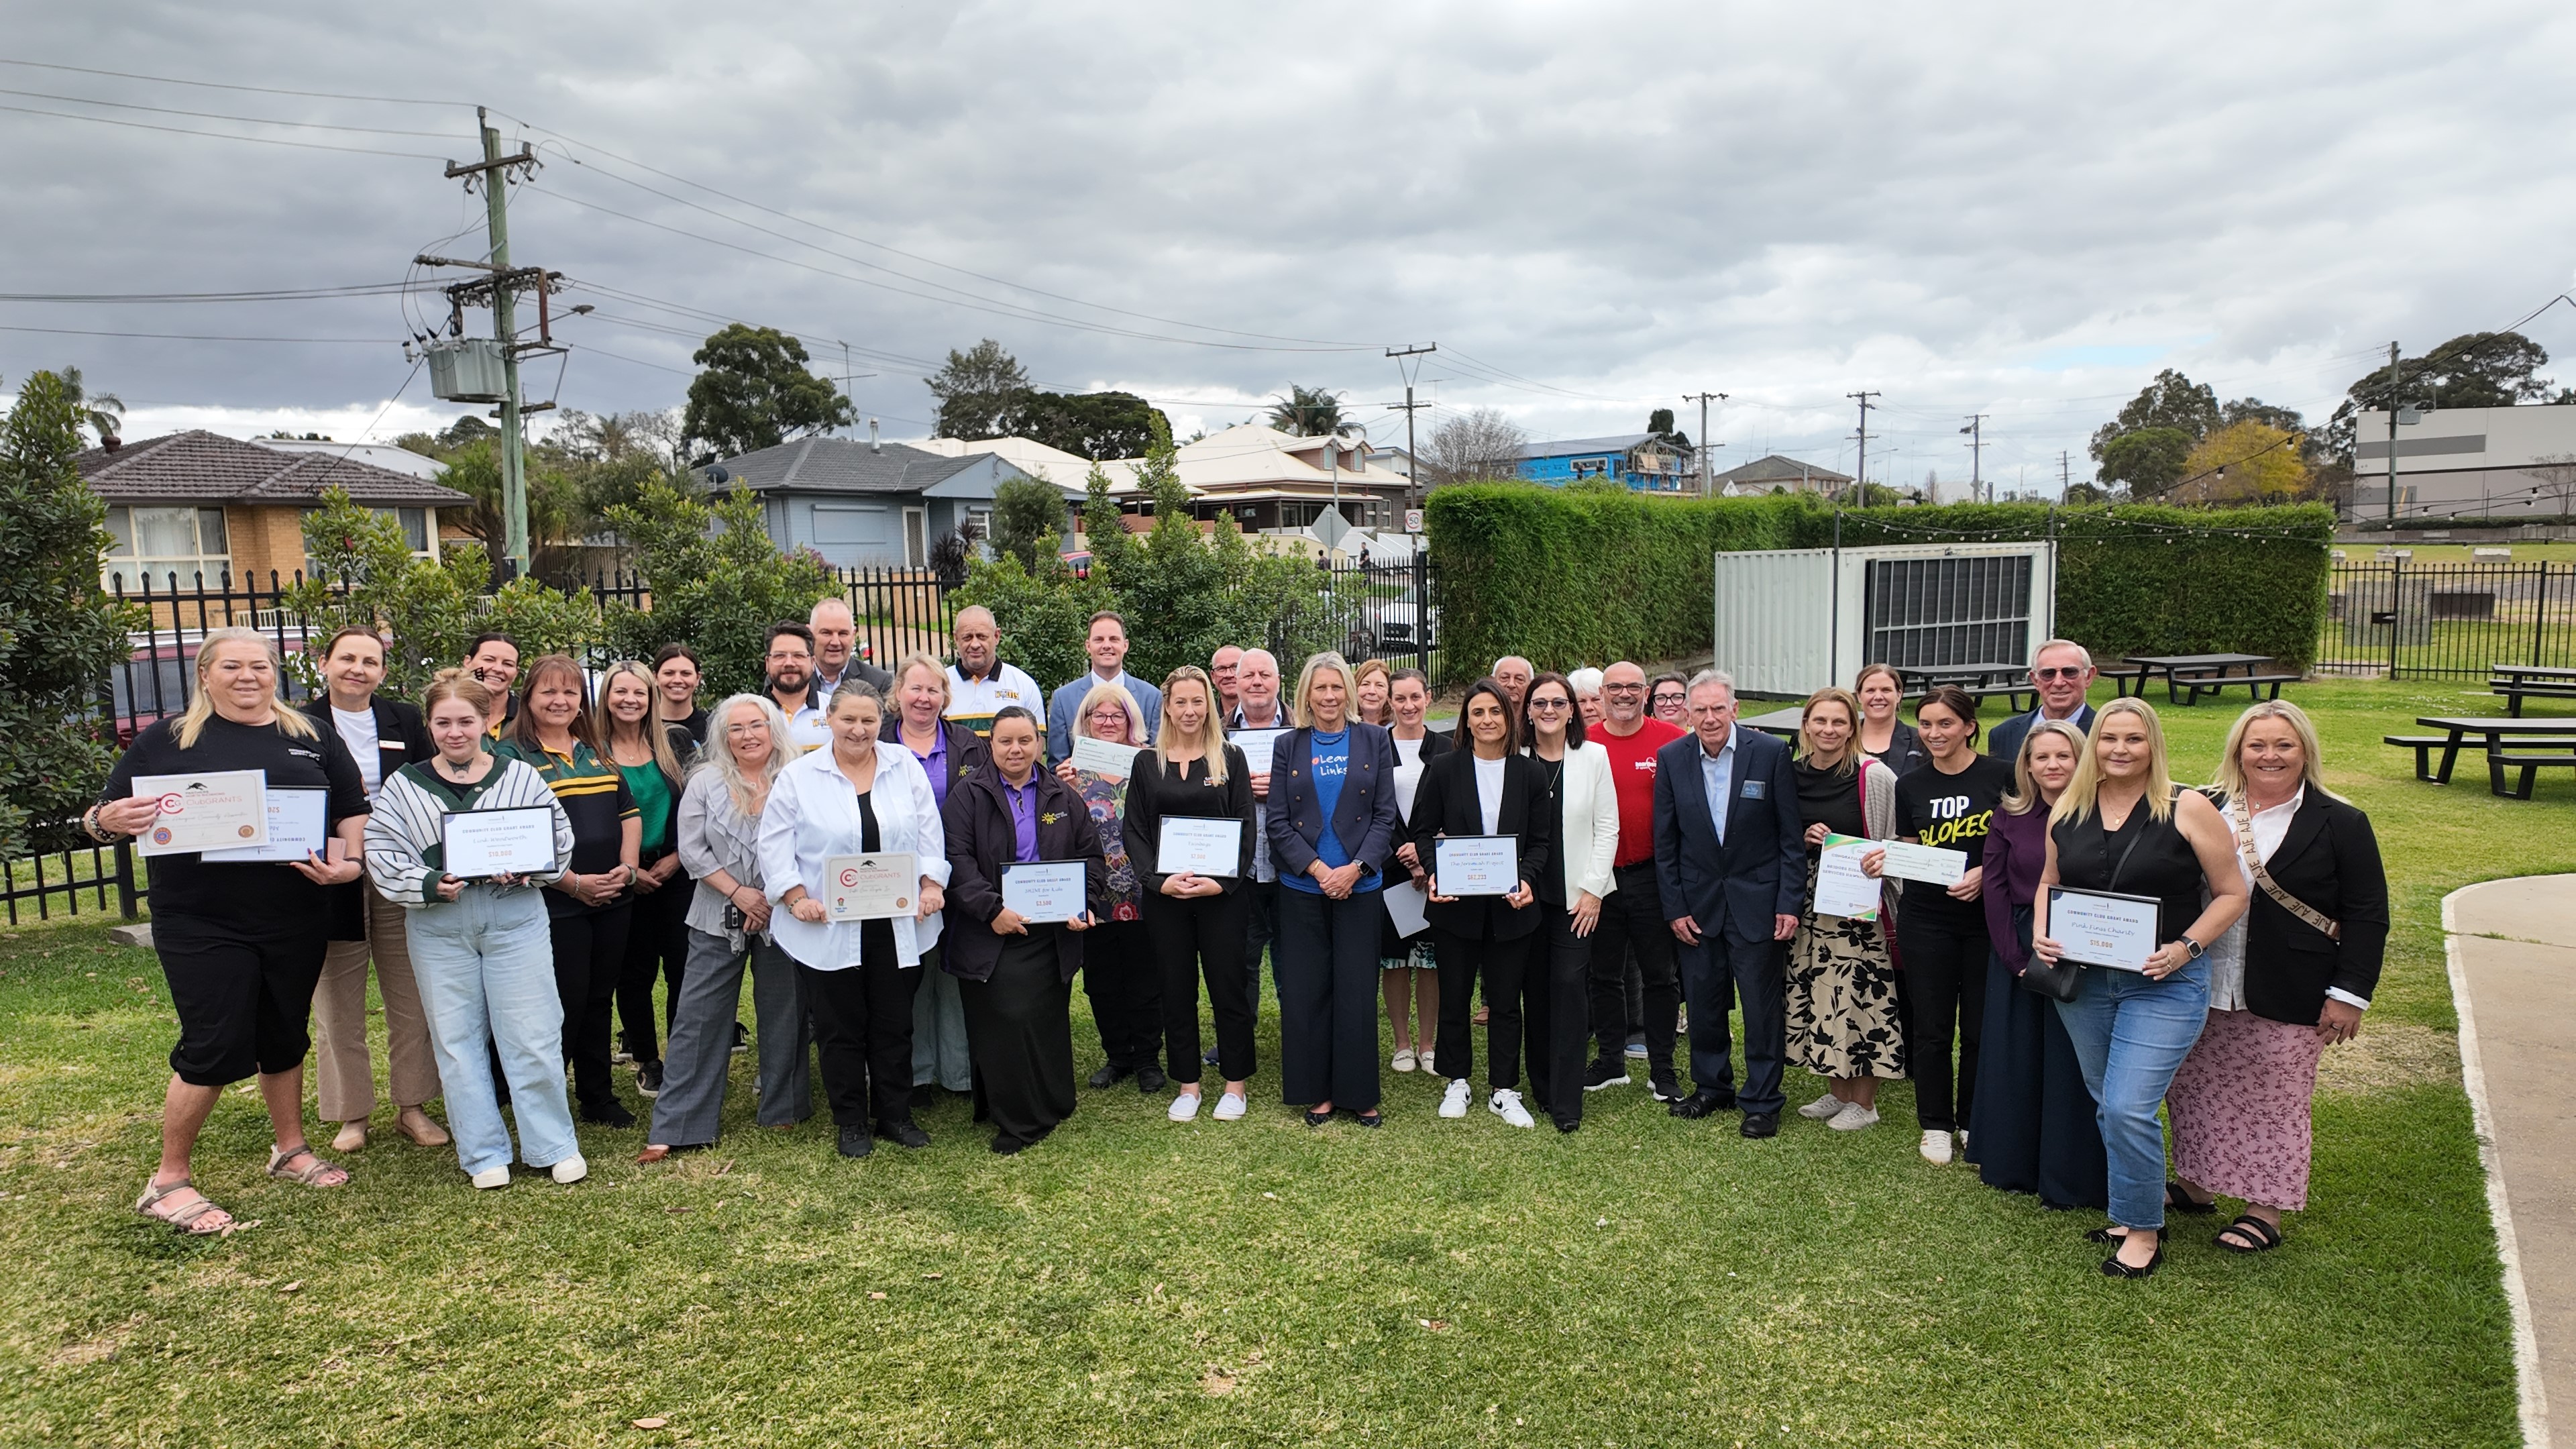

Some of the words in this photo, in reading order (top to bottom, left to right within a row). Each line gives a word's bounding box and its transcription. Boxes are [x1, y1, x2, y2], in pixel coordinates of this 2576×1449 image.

[1409, 517, 1419, 525] 50
[1320, 763, 1348, 776] Links
[186, 796, 242, 805] ClubGRANTS
[1929, 796, 1970, 818] TOP
[2233, 797, 2247, 812] AJE
[1919, 809, 1994, 847] BLOKES
[2237, 817, 2251, 832] AJE
[2242, 838, 2257, 853] AJE
[2249, 860, 2267, 879] AJE
[2265, 884, 2289, 901] AJE
[2288, 902, 2311, 917] AJE
[2108, 927, 2135, 936] Charity
[2090, 939, 2113, 949] $15,000
